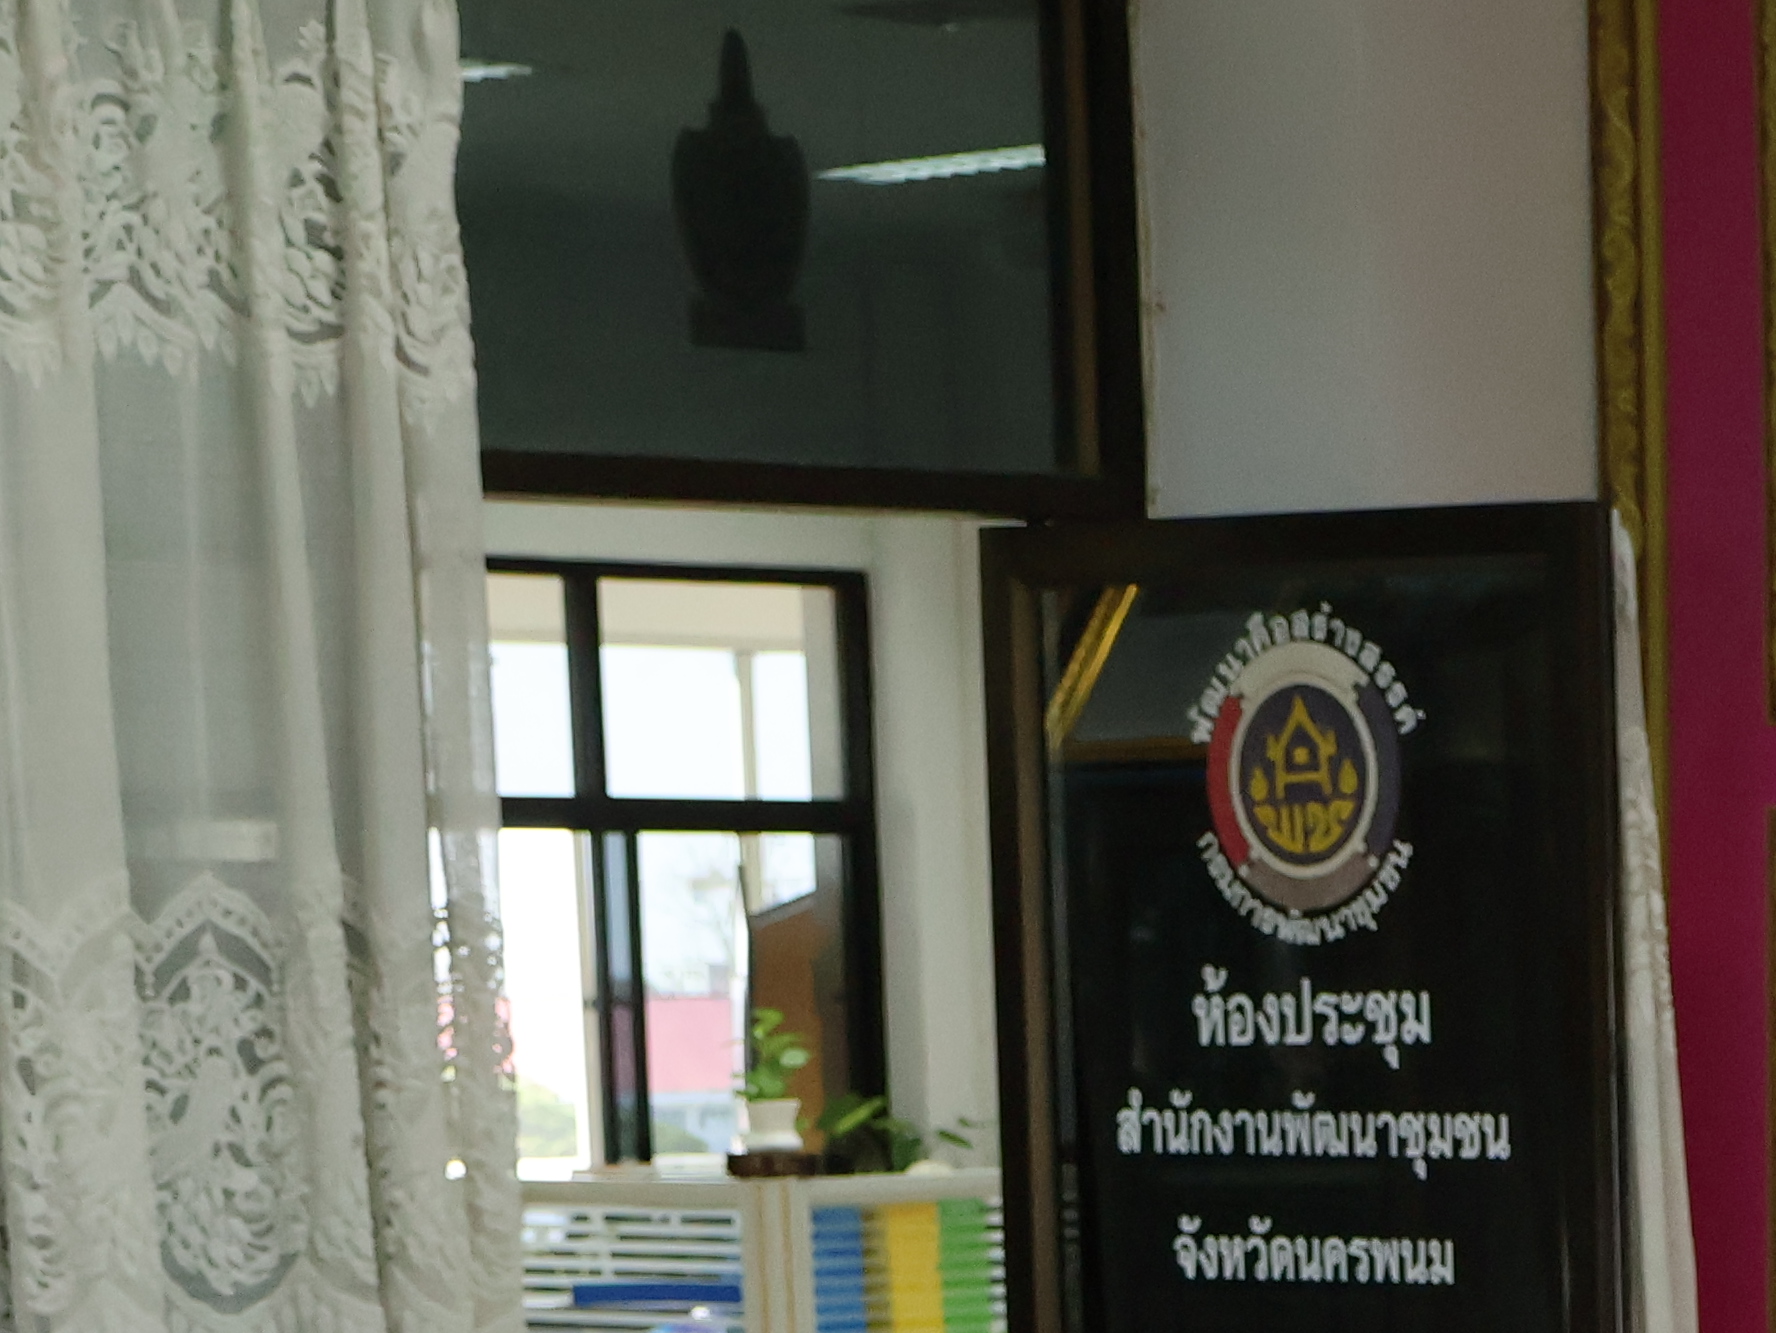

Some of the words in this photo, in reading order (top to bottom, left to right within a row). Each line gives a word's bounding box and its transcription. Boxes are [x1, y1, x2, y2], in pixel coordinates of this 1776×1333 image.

[1192, 964, 1431, 1070] ห้องประชุม
[1116, 1088, 1511, 1179] สำนักงานพัฒนาชุมชน
[1171, 1214, 1456, 1287] จังหวัดนครพนม
